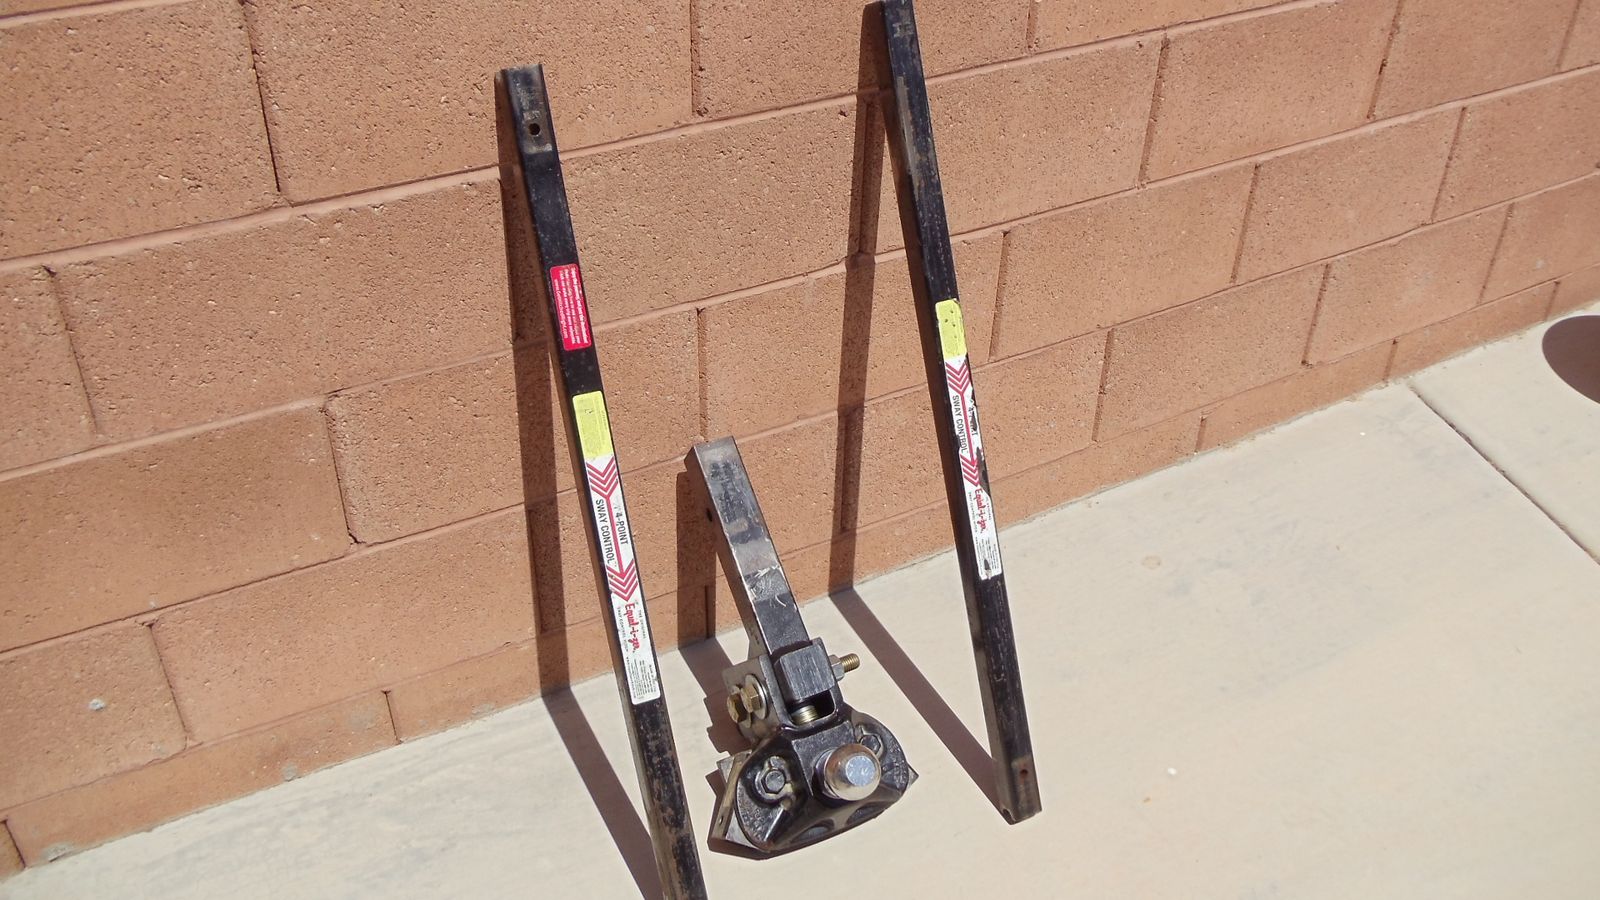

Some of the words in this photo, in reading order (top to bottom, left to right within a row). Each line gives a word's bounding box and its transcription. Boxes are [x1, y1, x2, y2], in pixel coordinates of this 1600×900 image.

[953, 395, 962, 416] SWAY
[595, 498, 608, 523] SWAY
[615, 512, 628, 545] 4-POINT
[600, 524, 615, 564] CONTROL
